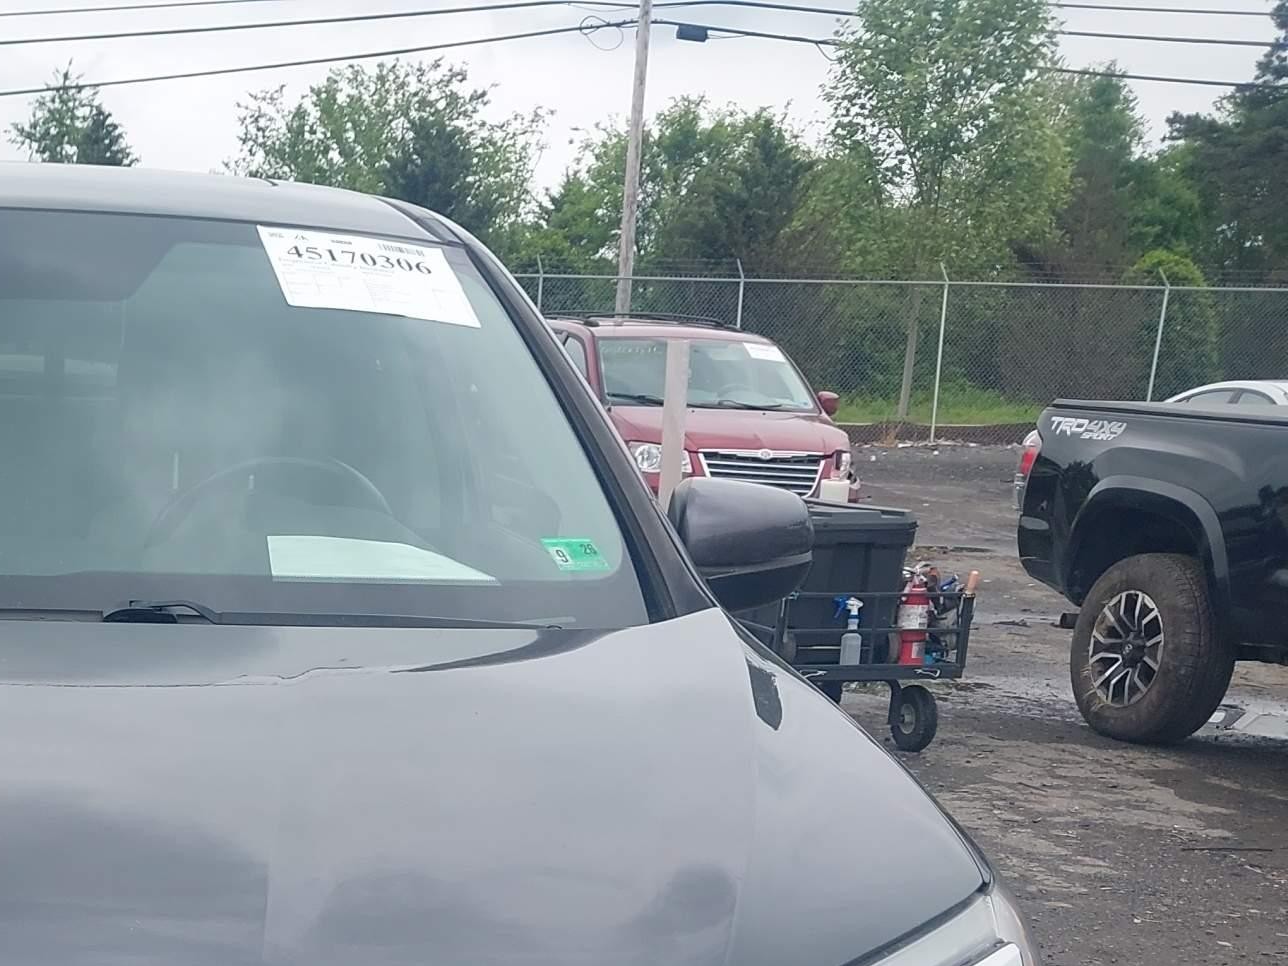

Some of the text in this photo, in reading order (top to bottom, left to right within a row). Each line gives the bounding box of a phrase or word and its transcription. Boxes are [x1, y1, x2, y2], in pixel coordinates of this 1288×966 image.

[287, 245, 432, 275] 45170306
[1051, 416, 1089, 436] TRD
[1080, 431, 1116, 440] SPORT
[555, 549, 569, 563] 9
